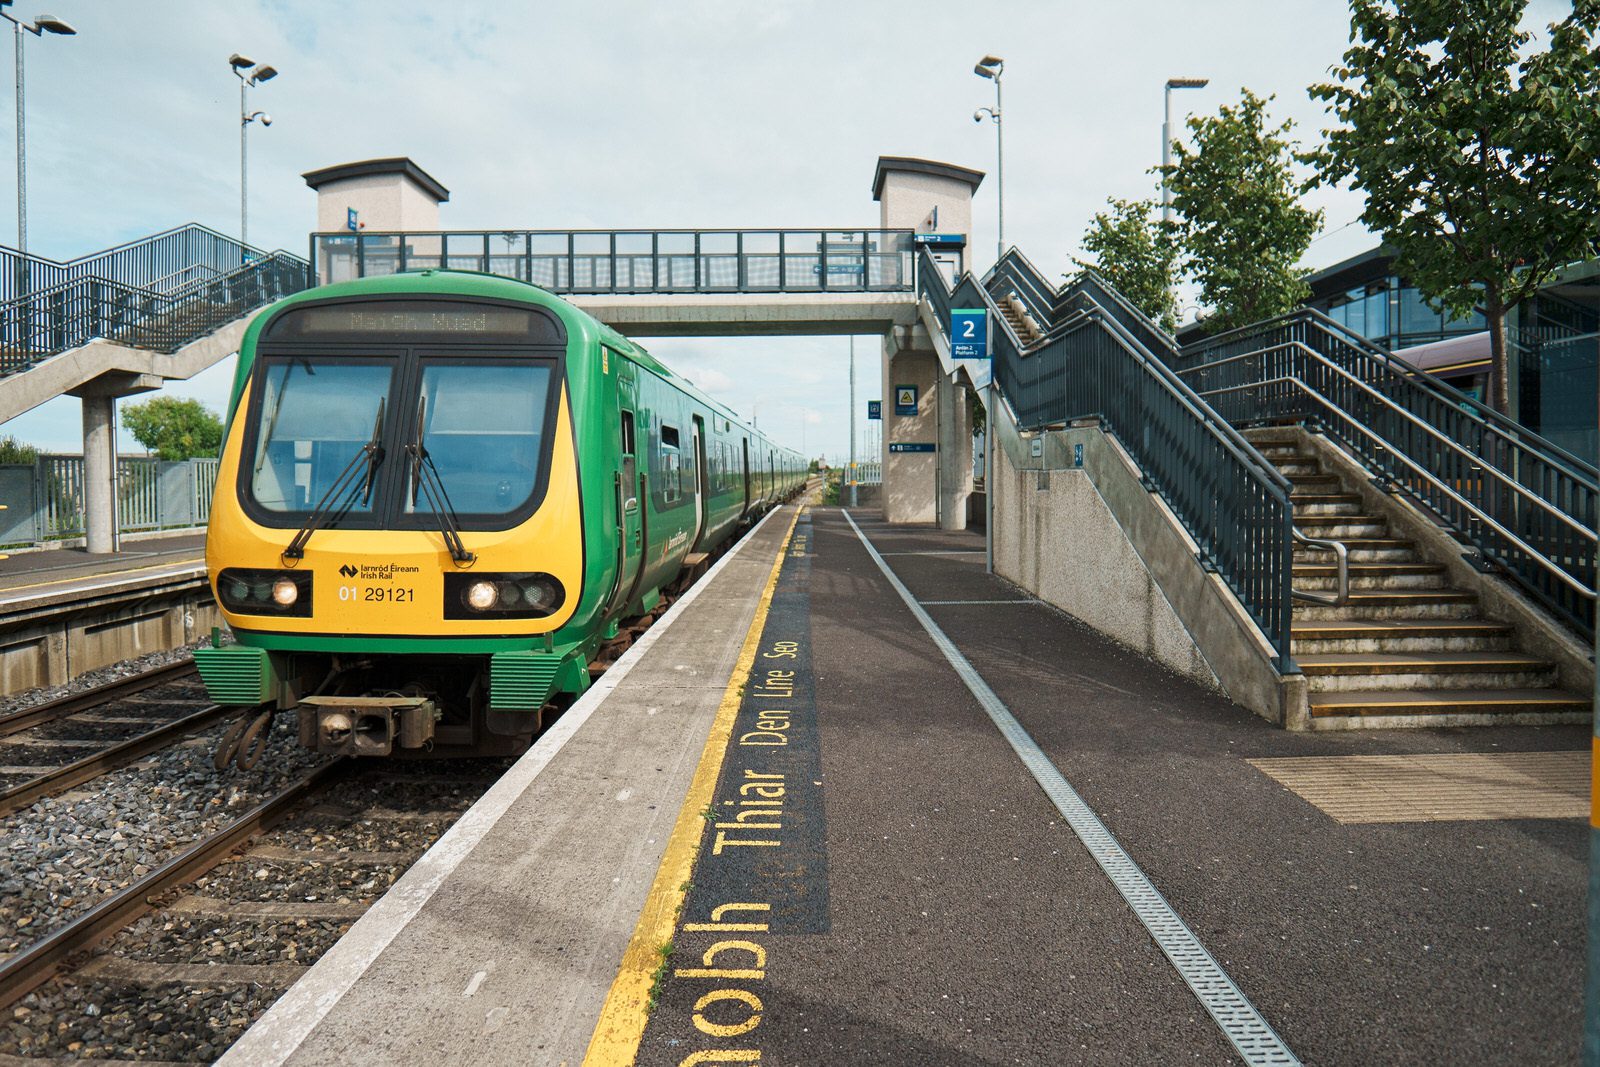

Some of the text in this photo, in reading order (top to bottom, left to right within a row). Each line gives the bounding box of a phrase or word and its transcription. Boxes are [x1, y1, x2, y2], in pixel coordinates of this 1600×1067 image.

[432, 313, 486, 331] Nuad
[963, 320, 975, 338] 2
[361, 562, 419, 573] Iarnród Éireann
[339, 586, 414, 602] 01 29121
[763, 641, 799, 659] Seo
[753, 670, 795, 698] Líne
[739, 710, 791, 746] Den
[712, 768, 785, 856] Thiar
